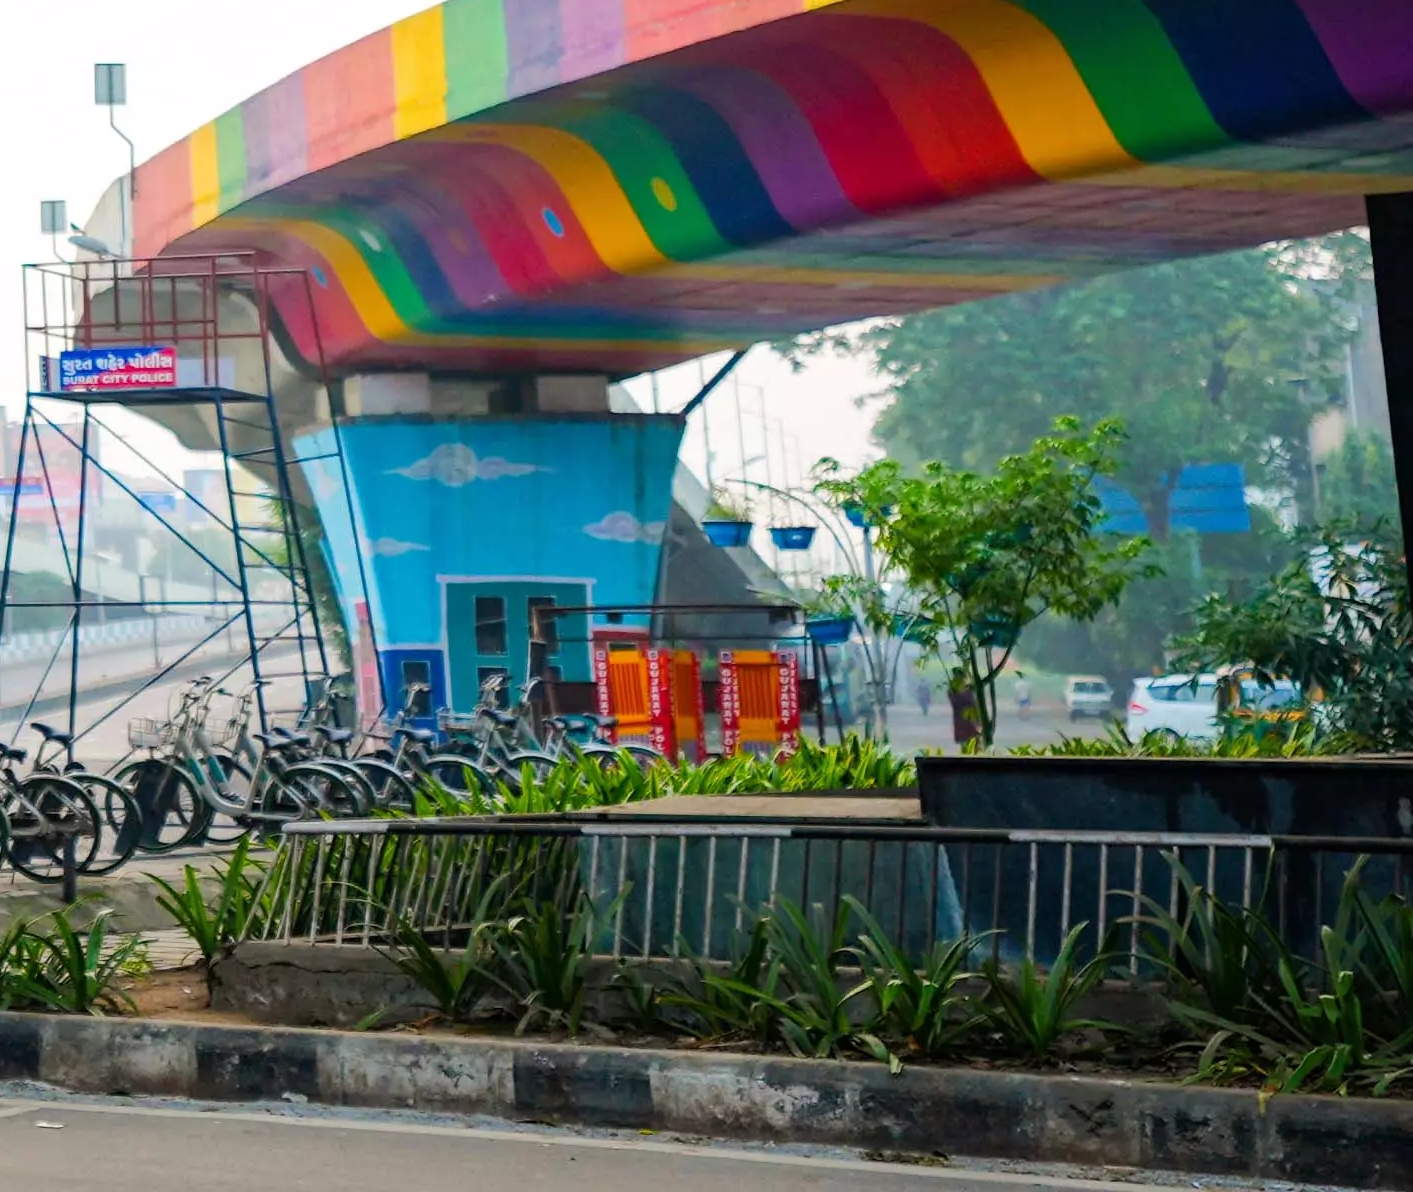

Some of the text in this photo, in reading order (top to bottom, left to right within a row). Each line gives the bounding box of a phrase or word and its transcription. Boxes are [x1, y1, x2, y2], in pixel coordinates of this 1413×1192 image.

[62, 358, 93, 376] સુરત
[96, 353, 126, 371] શહેર
[128, 351, 173, 369] પોલીસ
[62, 372, 174, 386] SURAT CITY POLICE
[597, 662, 610, 717] GUJARAT
[649, 662, 661, 717] GUJARAT
[720, 669, 733, 725] GUJARAT
[779, 669, 790, 725] GUJARAT
